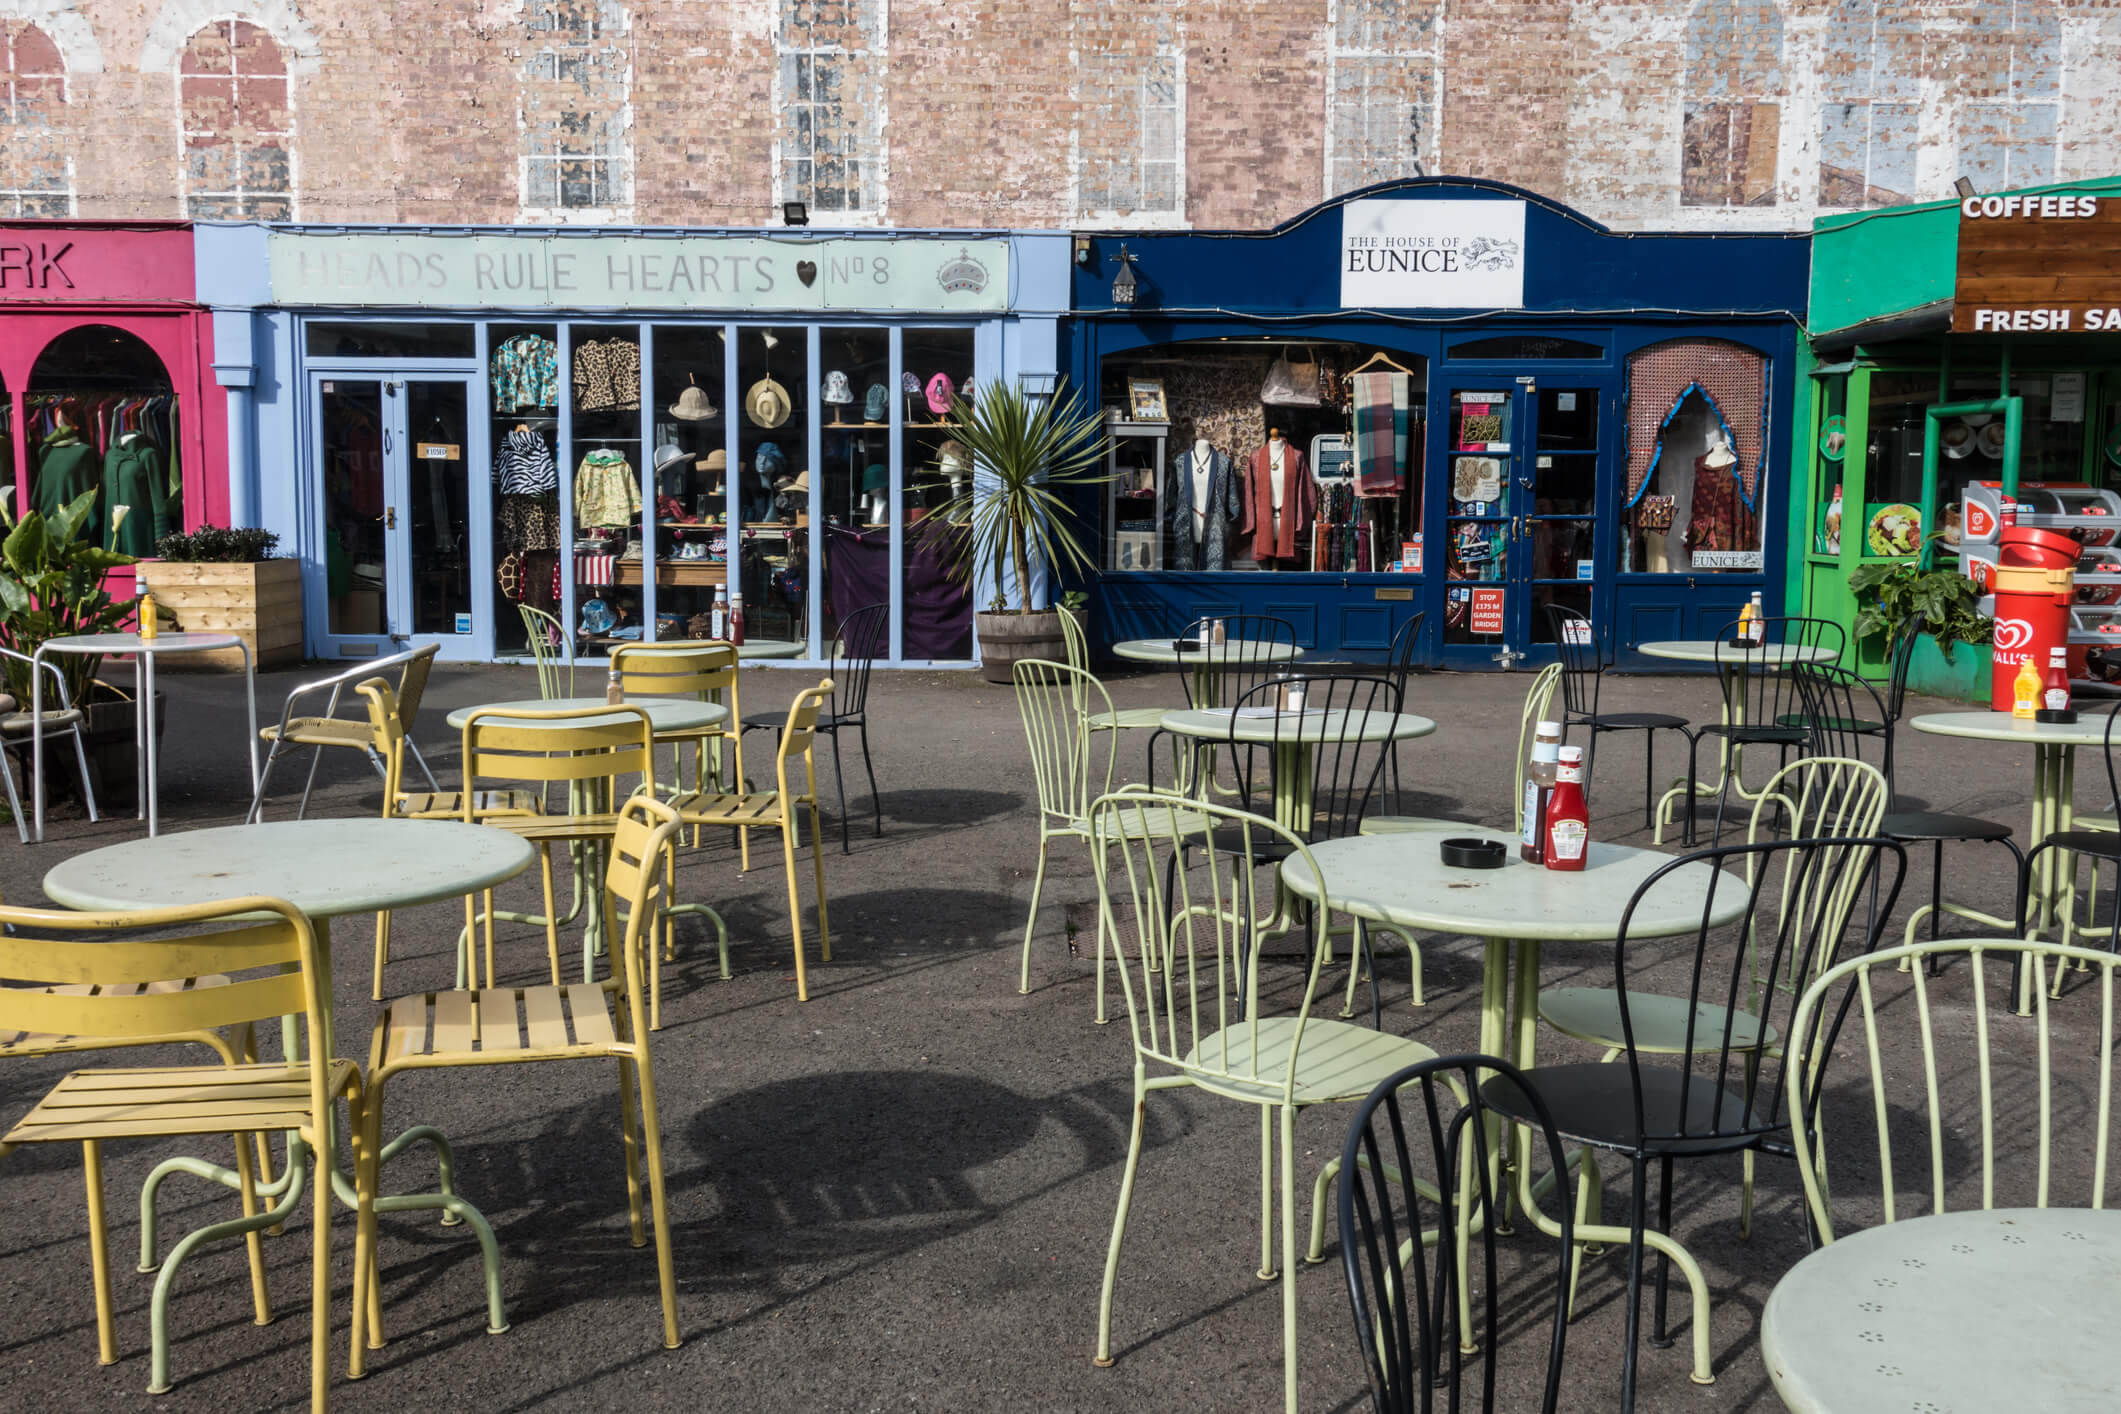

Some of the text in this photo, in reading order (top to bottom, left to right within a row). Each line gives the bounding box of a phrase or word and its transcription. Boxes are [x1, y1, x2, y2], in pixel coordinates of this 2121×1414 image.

[1962, 196, 2097, 218] COFFEES
[1349, 237, 1460, 247] THE HOUSE OF
[298, 250, 448, 289] HEADS
[475, 253, 578, 291] RULE
[606, 255, 775, 292] HEARTS
[872, 256, 889, 285] 8
[1348, 249, 1459, 272] EUNICE
[1975, 308, 2121, 331] FRESH SA
[1693, 556, 1738, 567] EUNICE
[1474, 620, 1500, 628] BRIDGE
